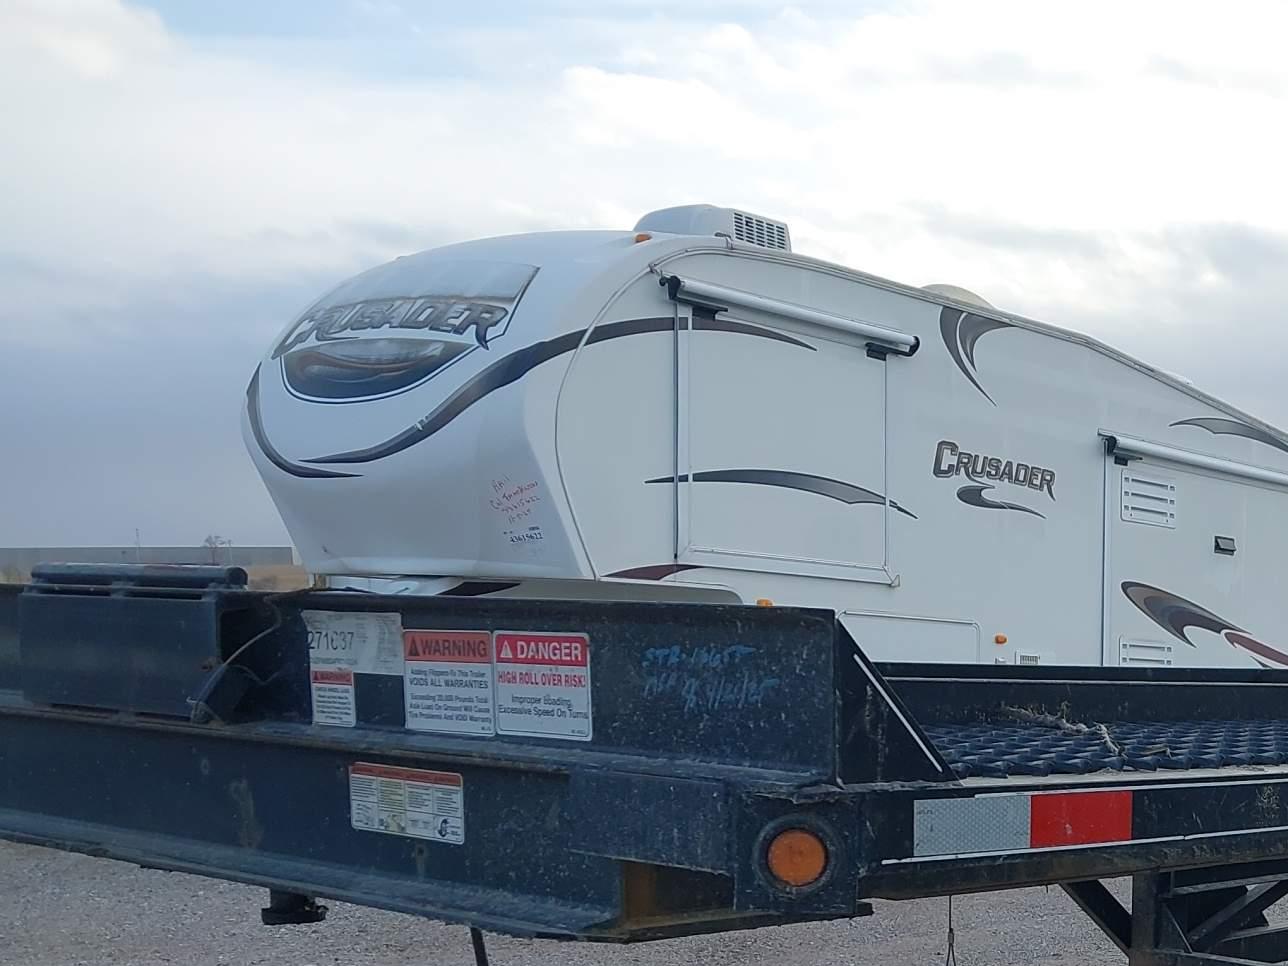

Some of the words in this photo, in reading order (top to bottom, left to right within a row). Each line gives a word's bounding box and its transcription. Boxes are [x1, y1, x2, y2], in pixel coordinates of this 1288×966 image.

[933, 440, 1056, 502] CRUSADER
[421, 639, 487, 658] WARNING
[516, 641, 582, 661] DANGER
[408, 677, 428, 686] VOIDS
[430, 678, 442, 687] ALL
[444, 679, 489, 689] WARRANTIES
[497, 671, 517, 685] HIGH
[519, 672, 539, 686] ROLL
[541, 673, 562, 687] OVER
[564, 674, 586, 688] RISK!
[511, 694, 541, 706] Improper
[498, 704, 532, 716] Excessive
[533, 706, 555, 718] Speed
[556, 707, 567, 718] On
